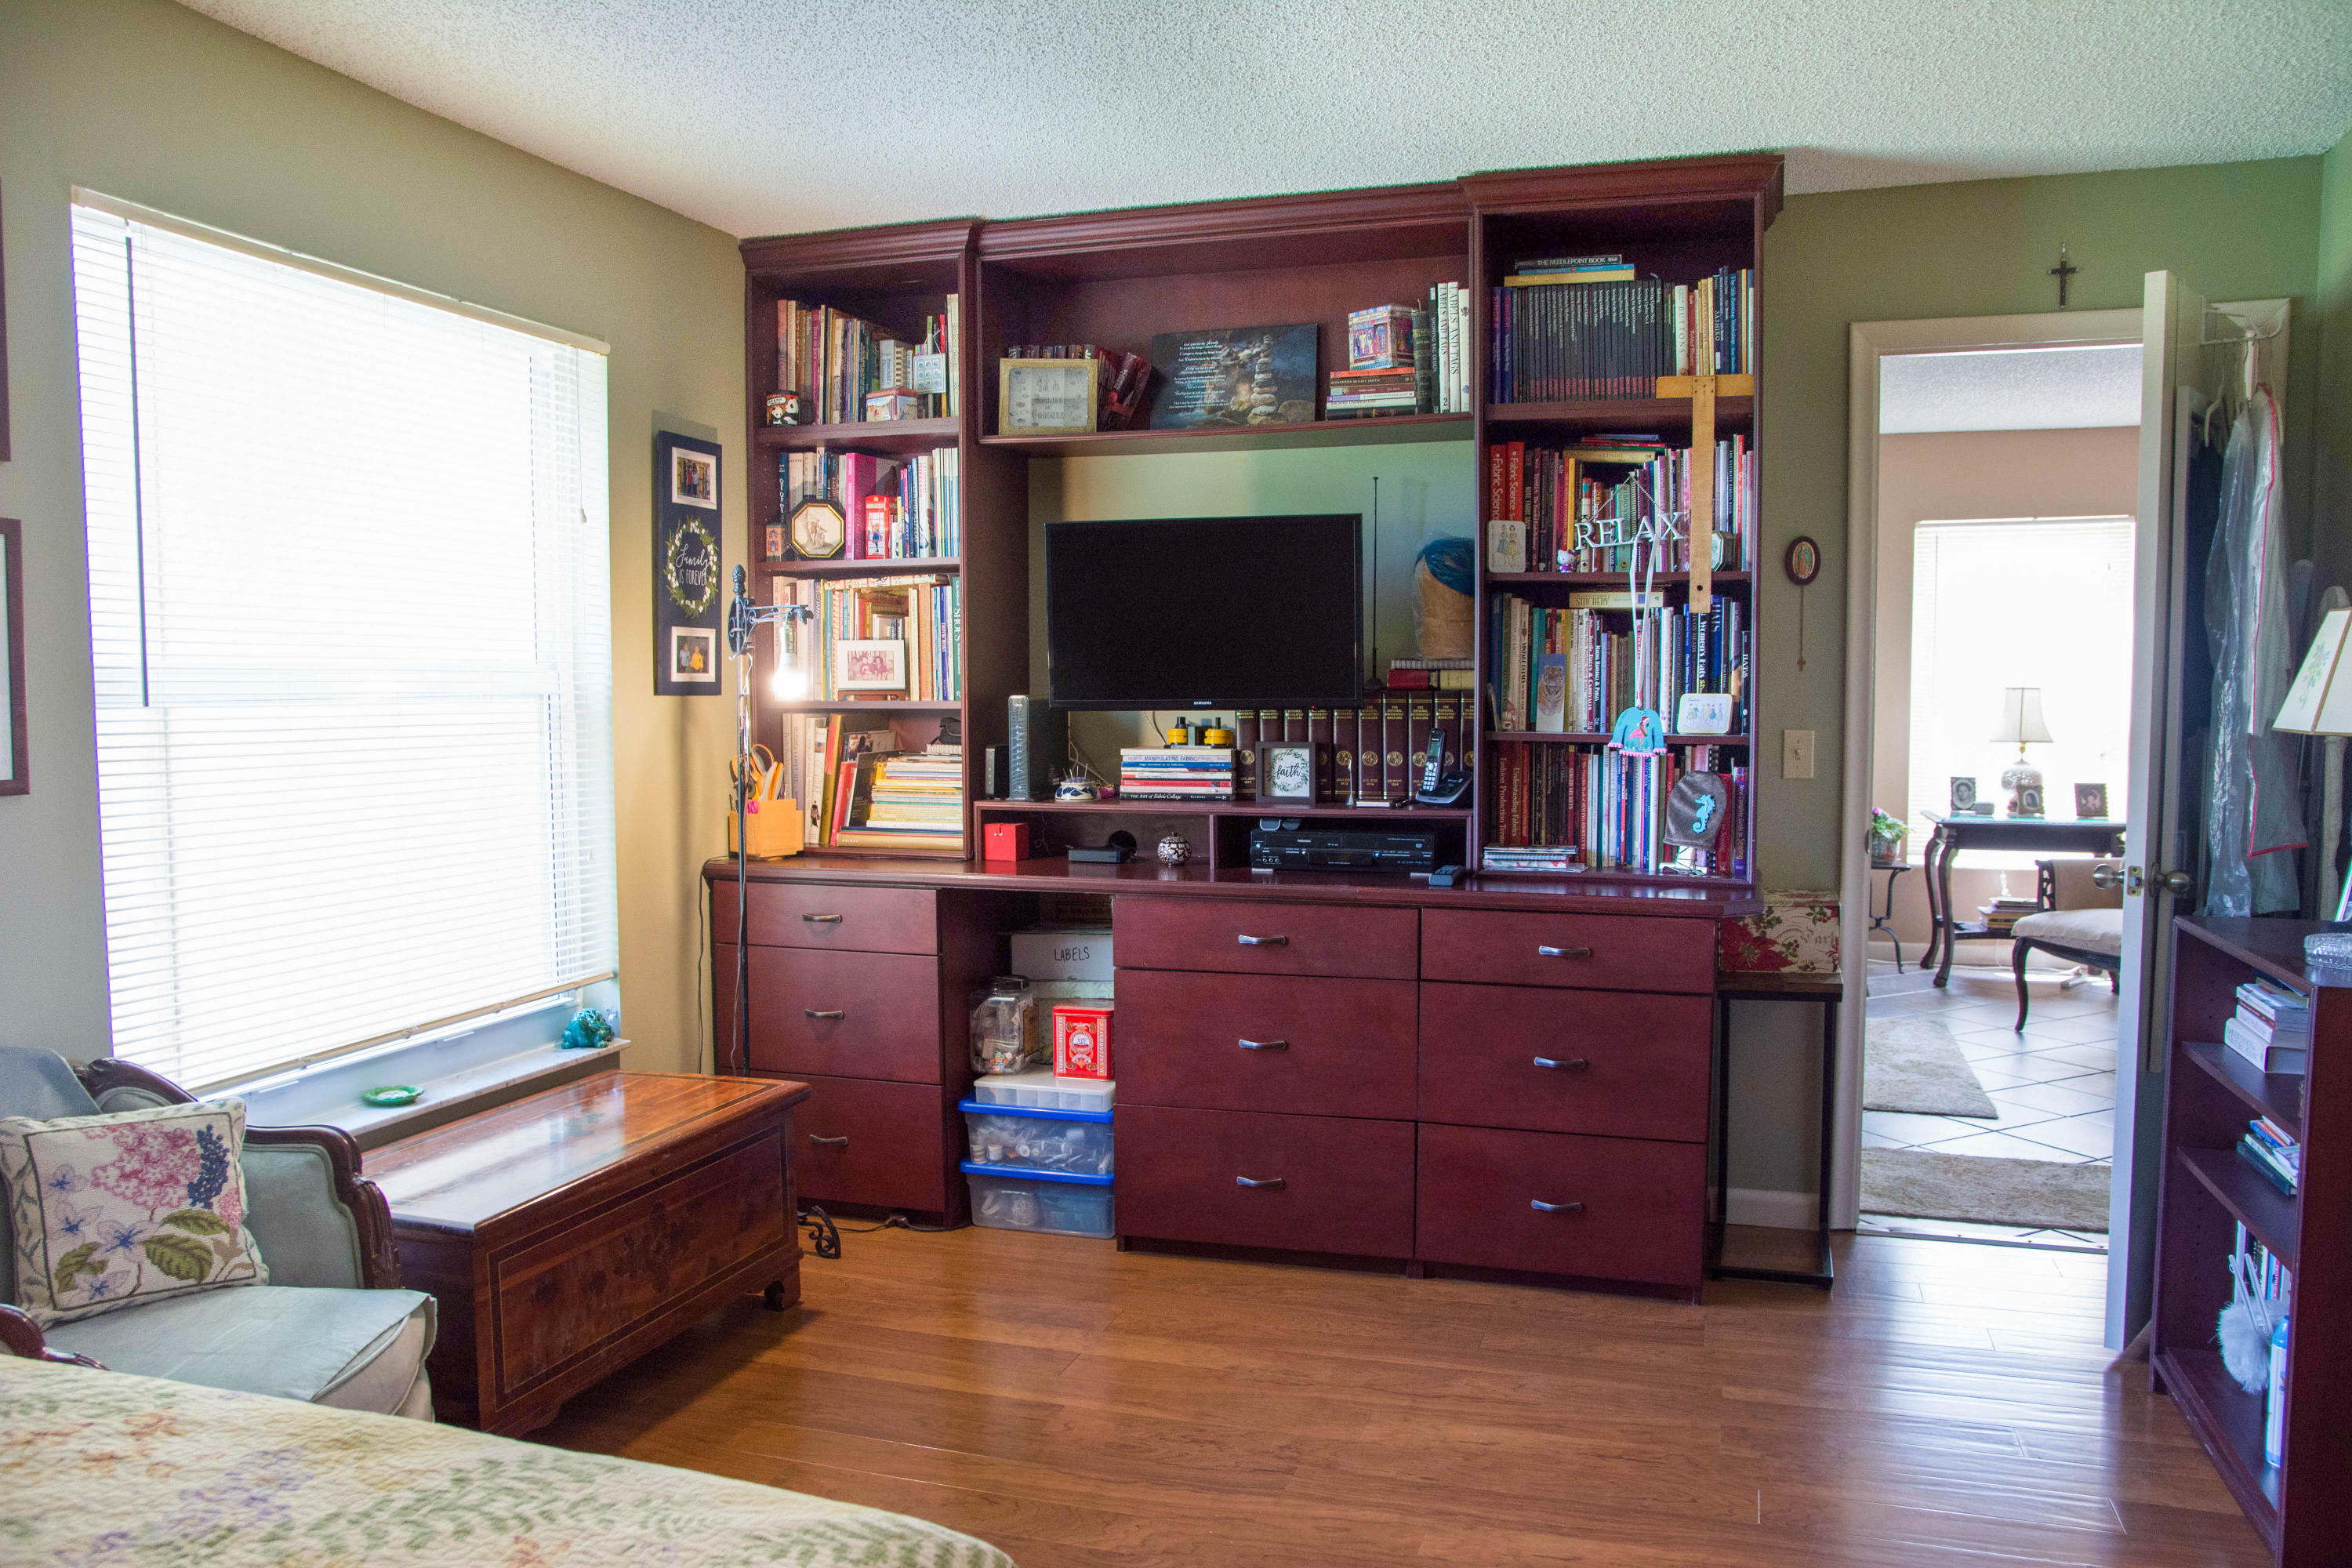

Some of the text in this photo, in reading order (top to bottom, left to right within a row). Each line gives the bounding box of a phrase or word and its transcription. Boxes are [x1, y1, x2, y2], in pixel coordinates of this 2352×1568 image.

[1450, 286, 1459, 375] LABELS AND TAGS
[1493, 458, 1503, 486] Fabric
[1508, 456, 1519, 510] Fabric Science
[1574, 510, 1687, 551] RELAX
[675, 543, 711, 575] Family
[679, 568, 684, 584] IS
[1711, 604, 1721, 633] HATS
[1699, 620, 1708, 678] Women's Hats
[1276, 762, 1301, 779] faith
[1054, 946, 1090, 963] LABELS
